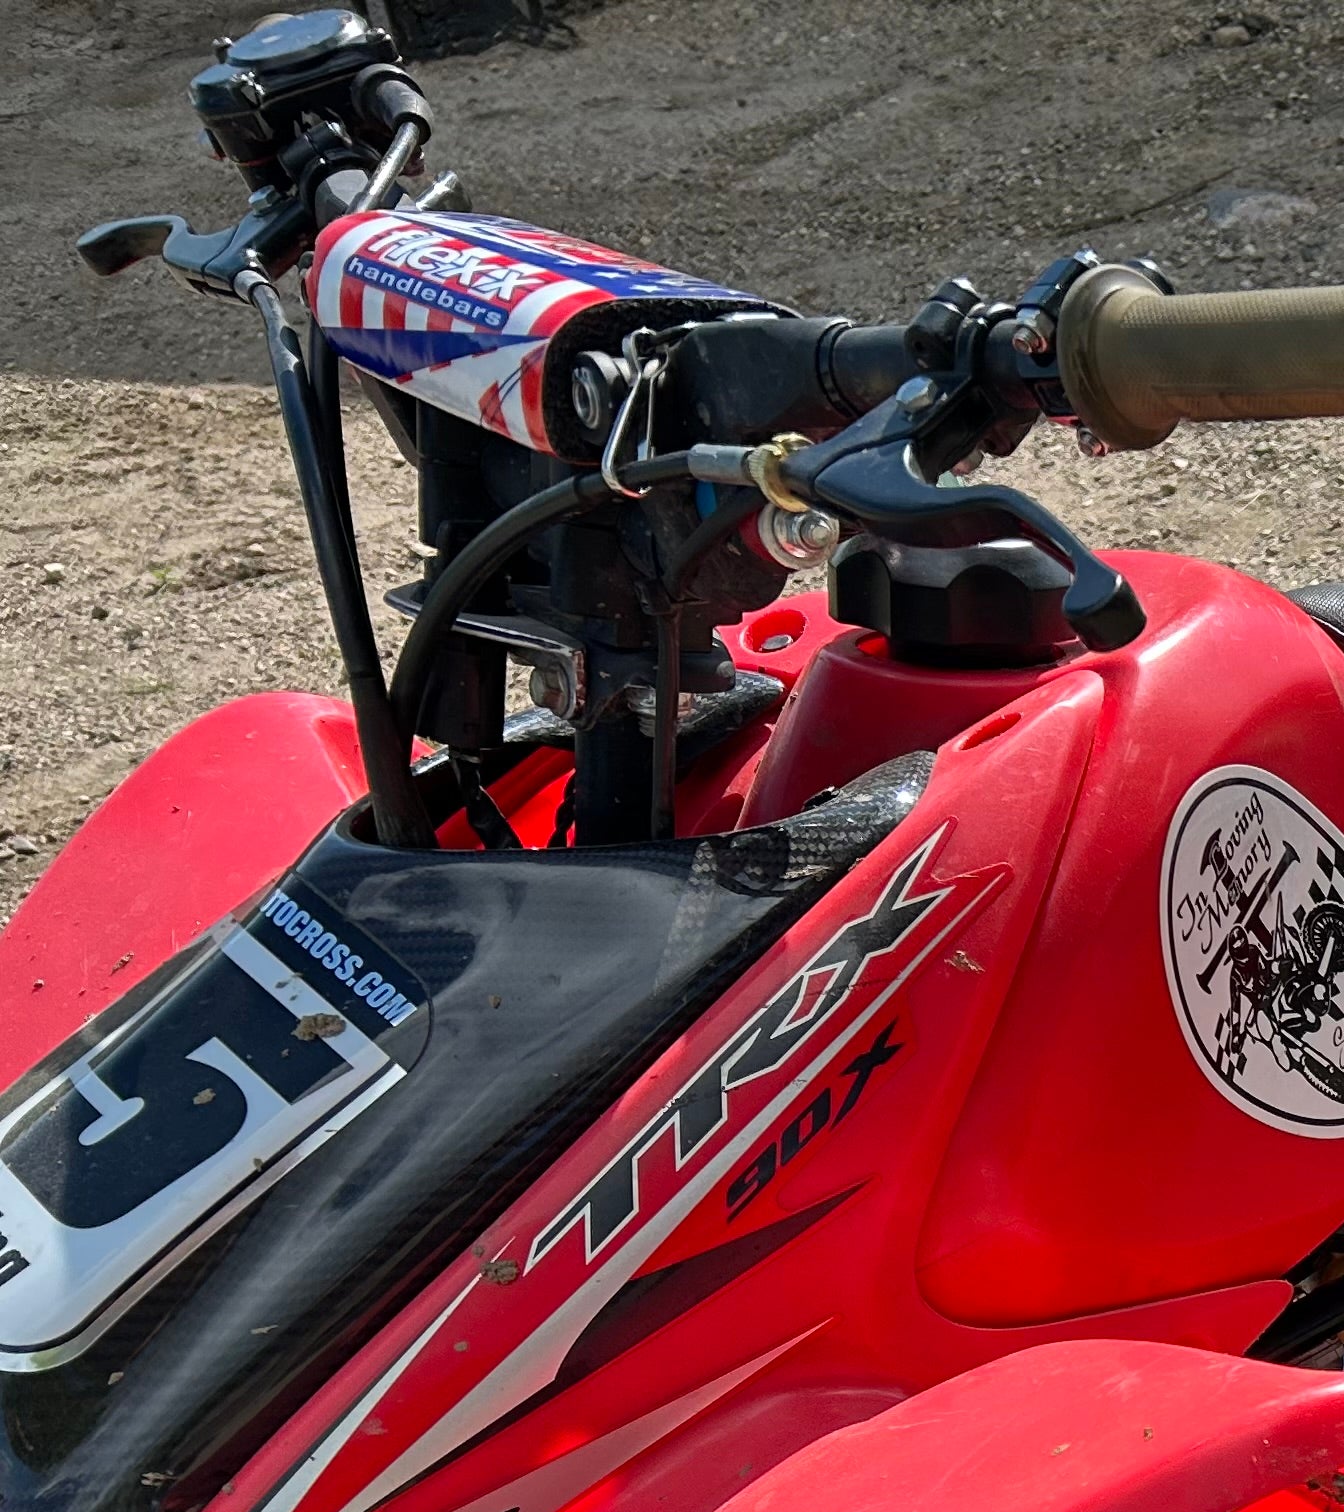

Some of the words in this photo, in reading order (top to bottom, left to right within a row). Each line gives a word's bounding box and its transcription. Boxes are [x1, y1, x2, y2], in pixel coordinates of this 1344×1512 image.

[347, 256, 503, 327] handlebars
[1197, 827, 1272, 955] Memory
[1209, 791, 1264, 893] Loving
[261, 888, 418, 1027] TOCROSS.COM
[522, 817, 956, 1277] TRX
[725, 1019, 906, 1224] 90X
